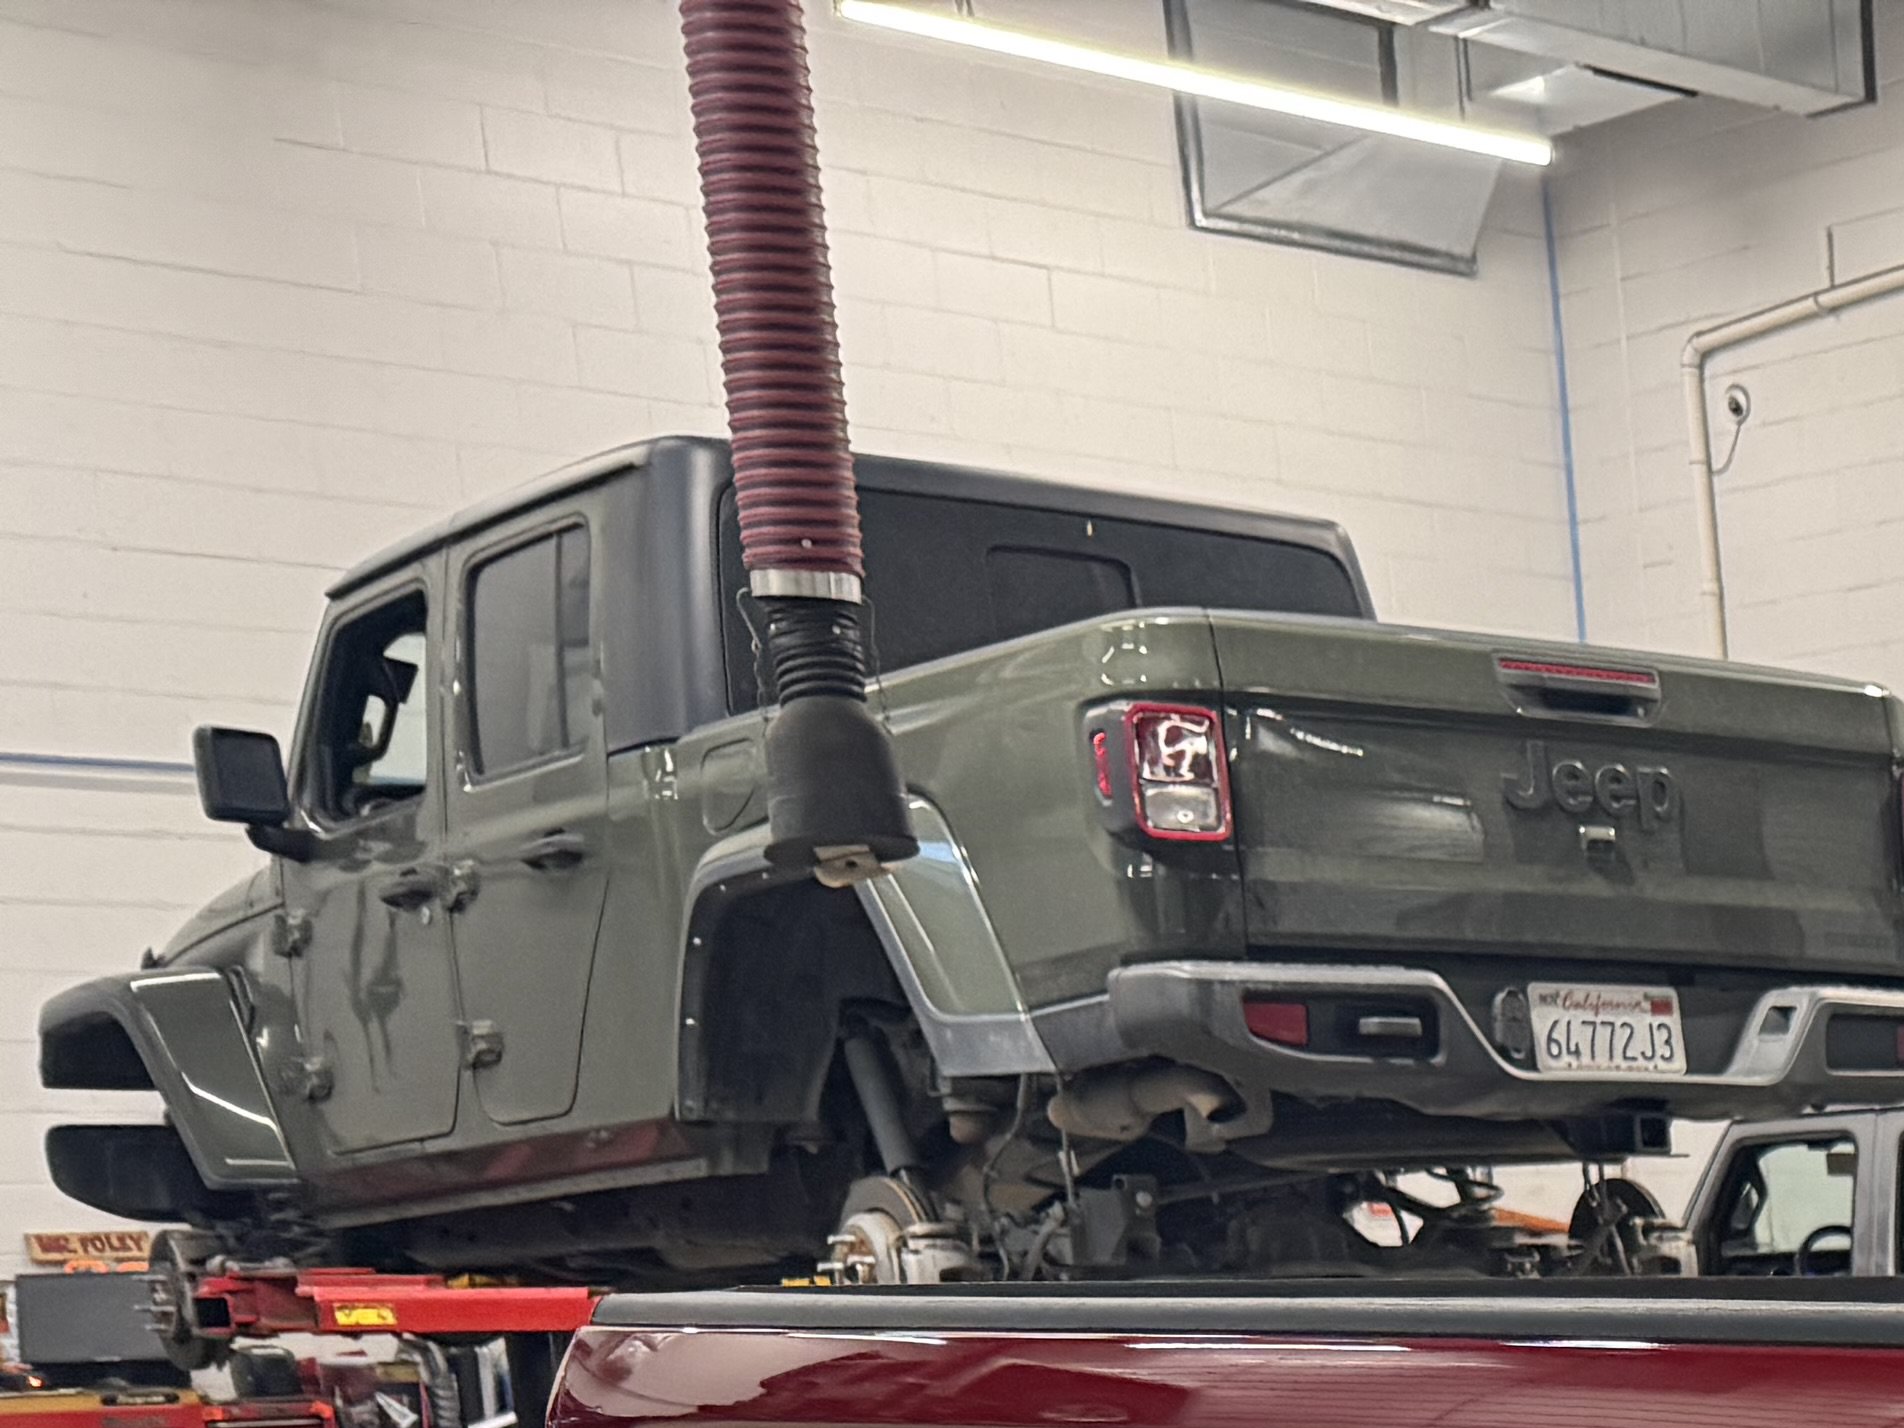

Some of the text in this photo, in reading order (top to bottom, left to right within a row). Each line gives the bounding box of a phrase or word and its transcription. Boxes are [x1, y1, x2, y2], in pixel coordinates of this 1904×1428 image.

[1501, 739, 1670, 832] Jeep
[1562, 991, 1650, 1017] California
[1546, 1019, 1675, 1061] 64772J3
